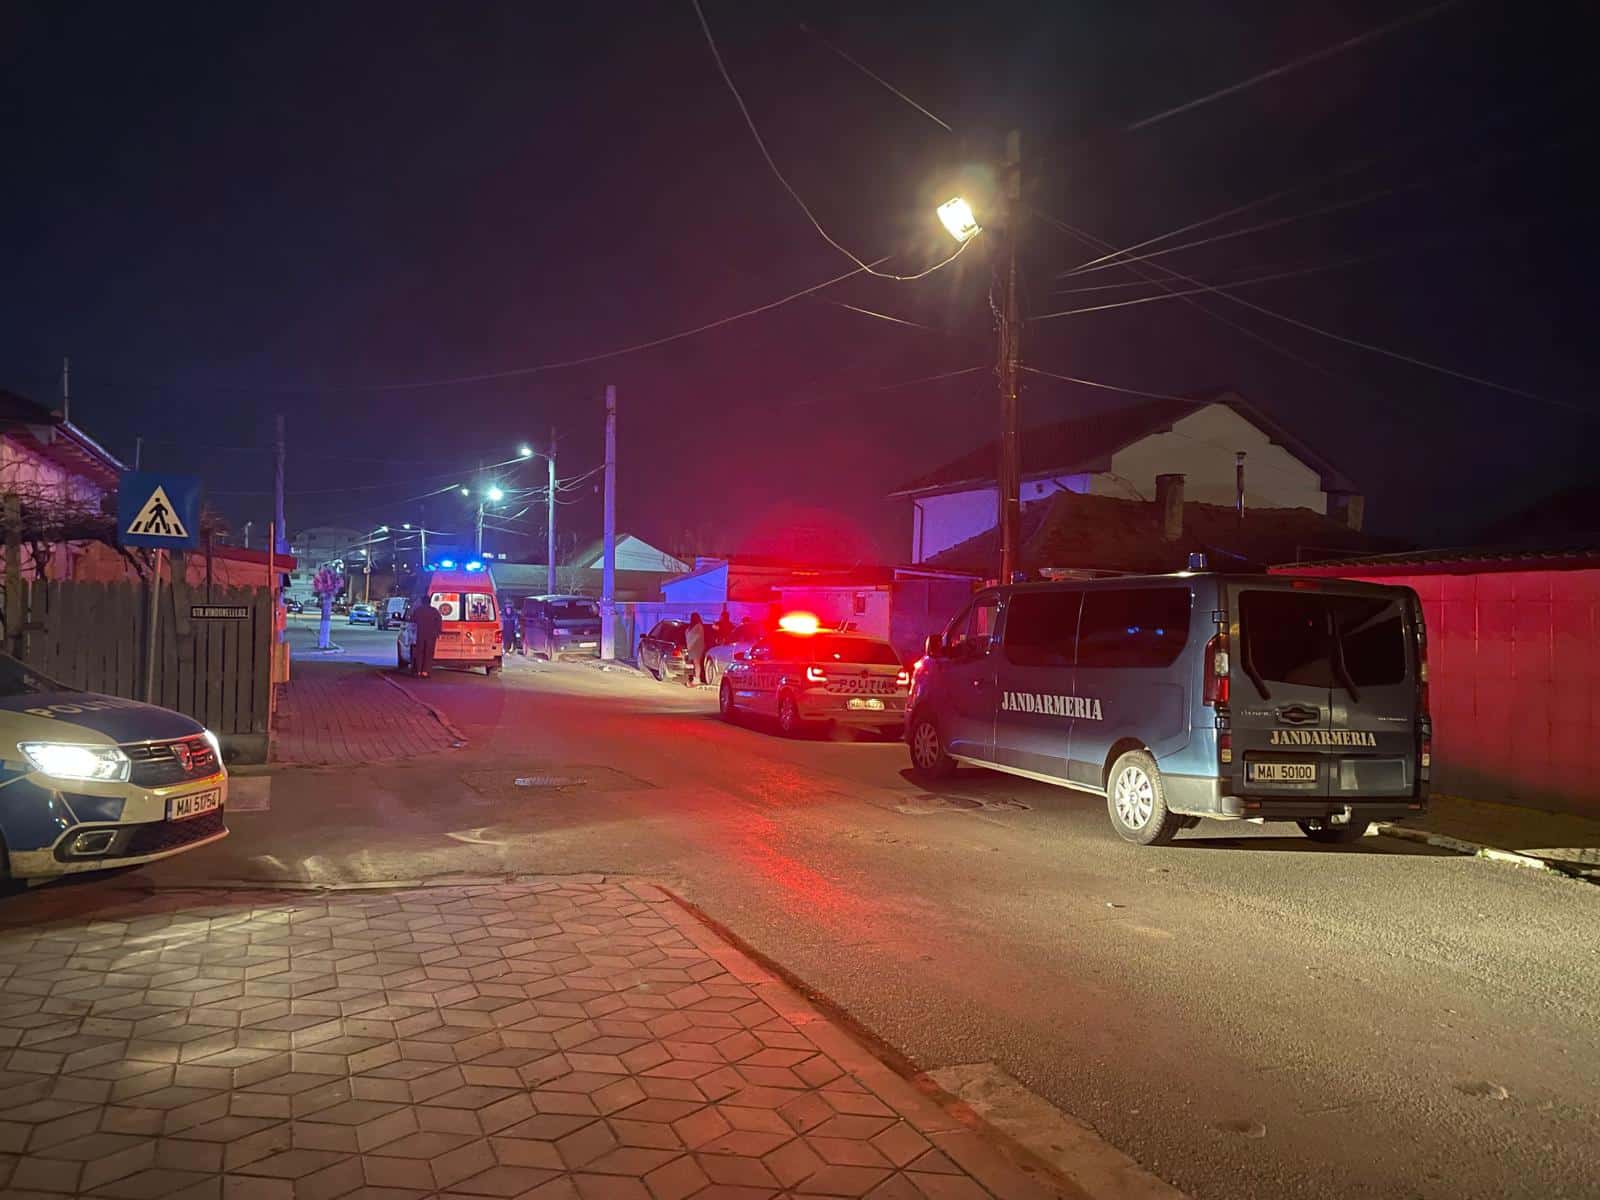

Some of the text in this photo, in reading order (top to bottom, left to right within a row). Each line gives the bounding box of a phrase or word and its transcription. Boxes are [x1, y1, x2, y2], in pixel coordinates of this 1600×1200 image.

[1001, 691, 1103, 720] JANDARMERIA
[1270, 730, 1376, 747] JANDARMERIA
[1257, 766, 1312, 779] MAI 50100
[176, 799, 192, 816] MAI
